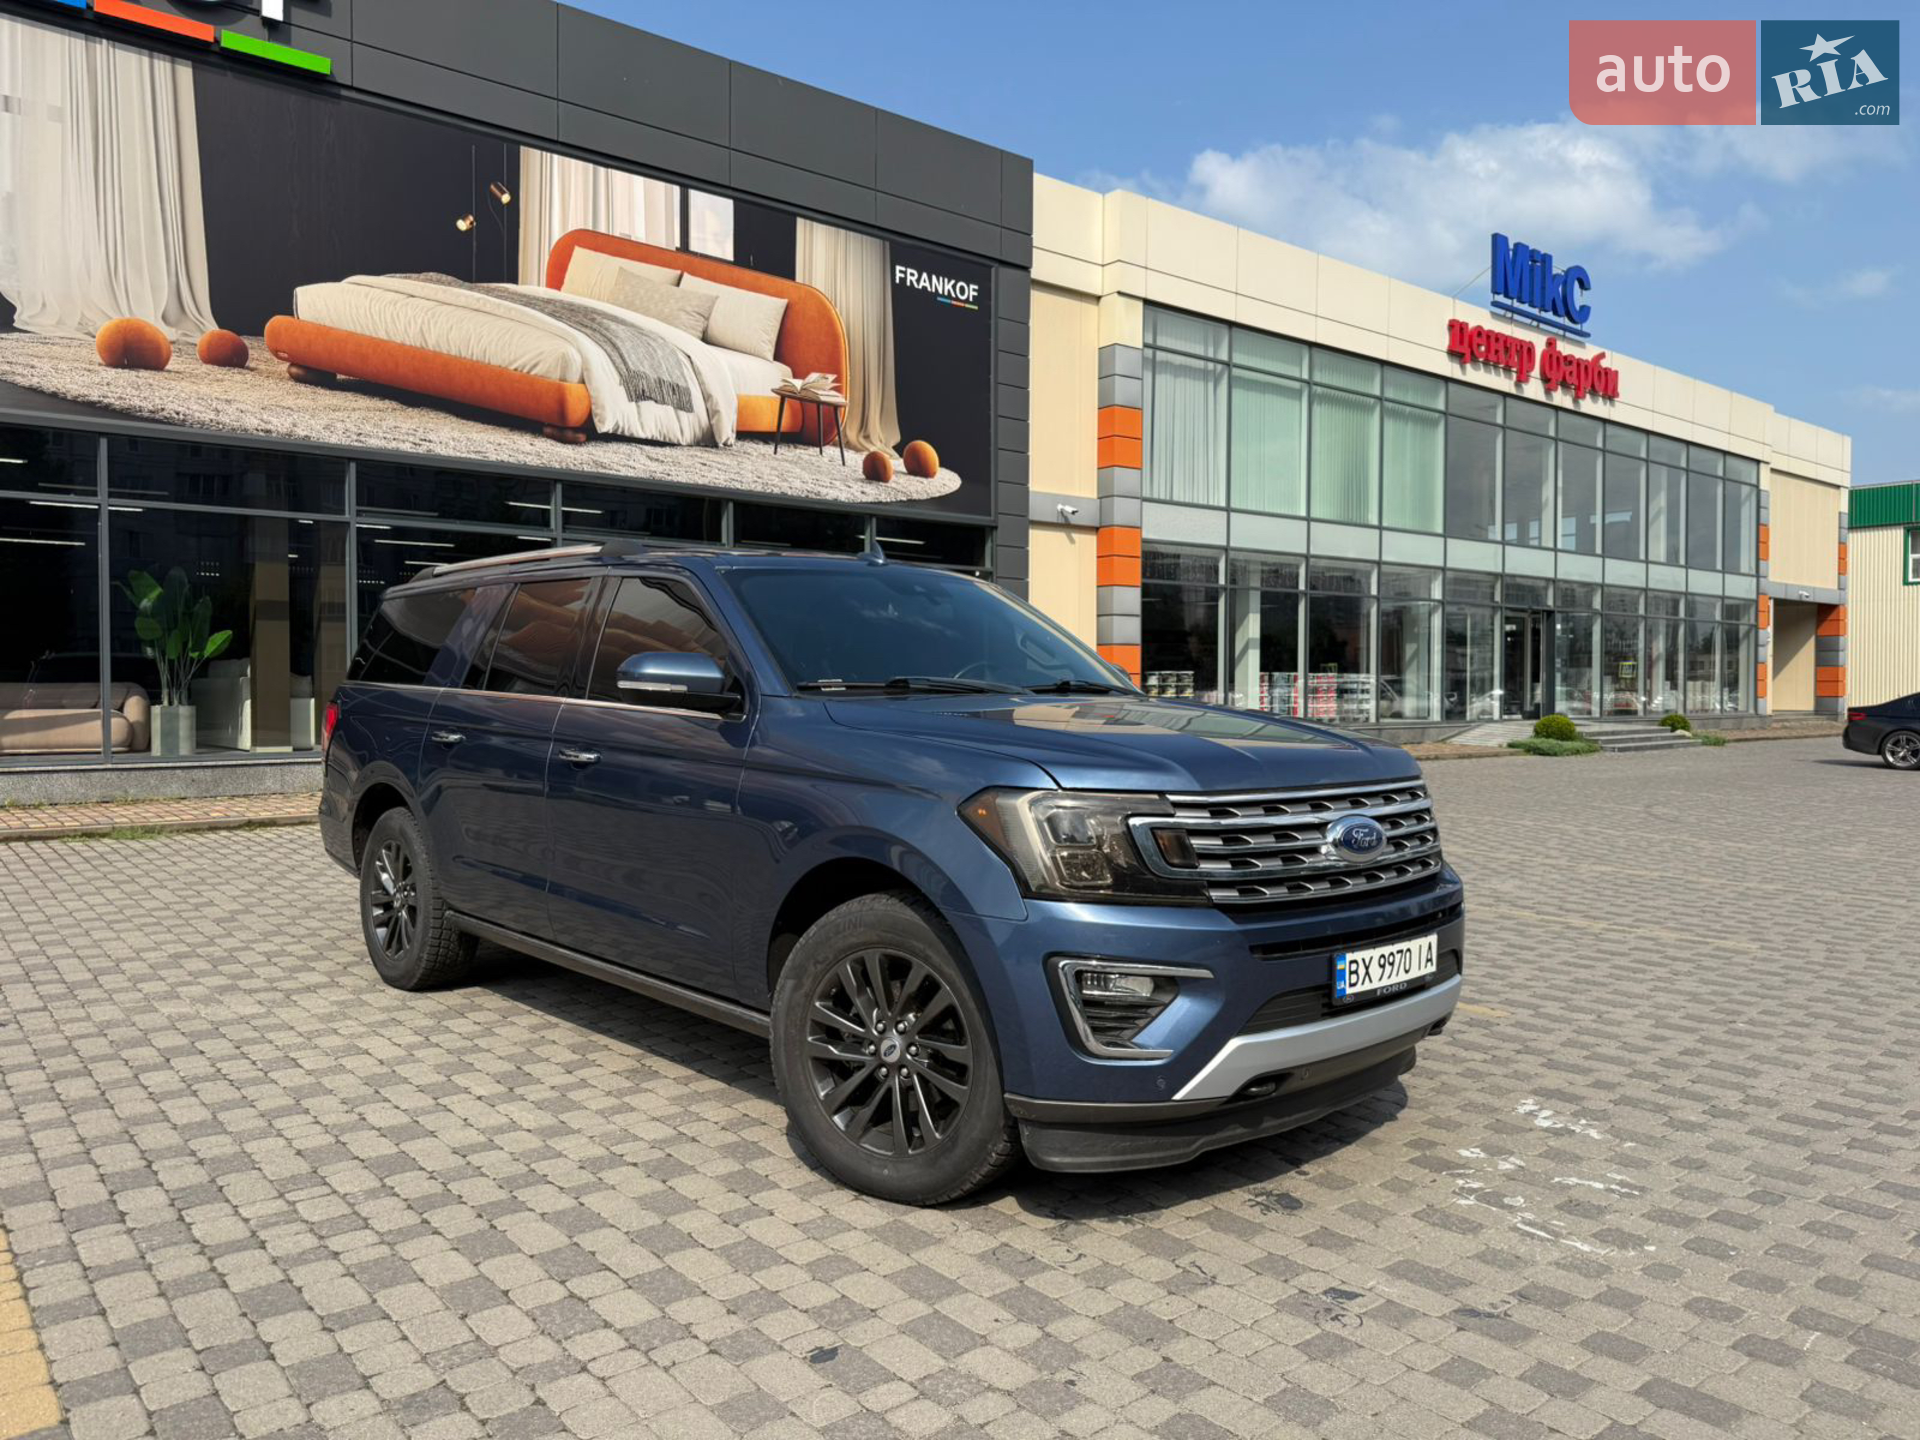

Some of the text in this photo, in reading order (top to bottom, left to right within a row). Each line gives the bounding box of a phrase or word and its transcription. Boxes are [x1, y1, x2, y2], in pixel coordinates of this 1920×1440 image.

[895, 265, 979, 302] FRANKOF
[1447, 318, 1619, 400] центр фарби
[1351, 828, 1378, 848] Ford
[1348, 956, 1374, 988] BX
[1378, 947, 1412, 982] 9970
[1377, 982, 1408, 996] FORD
